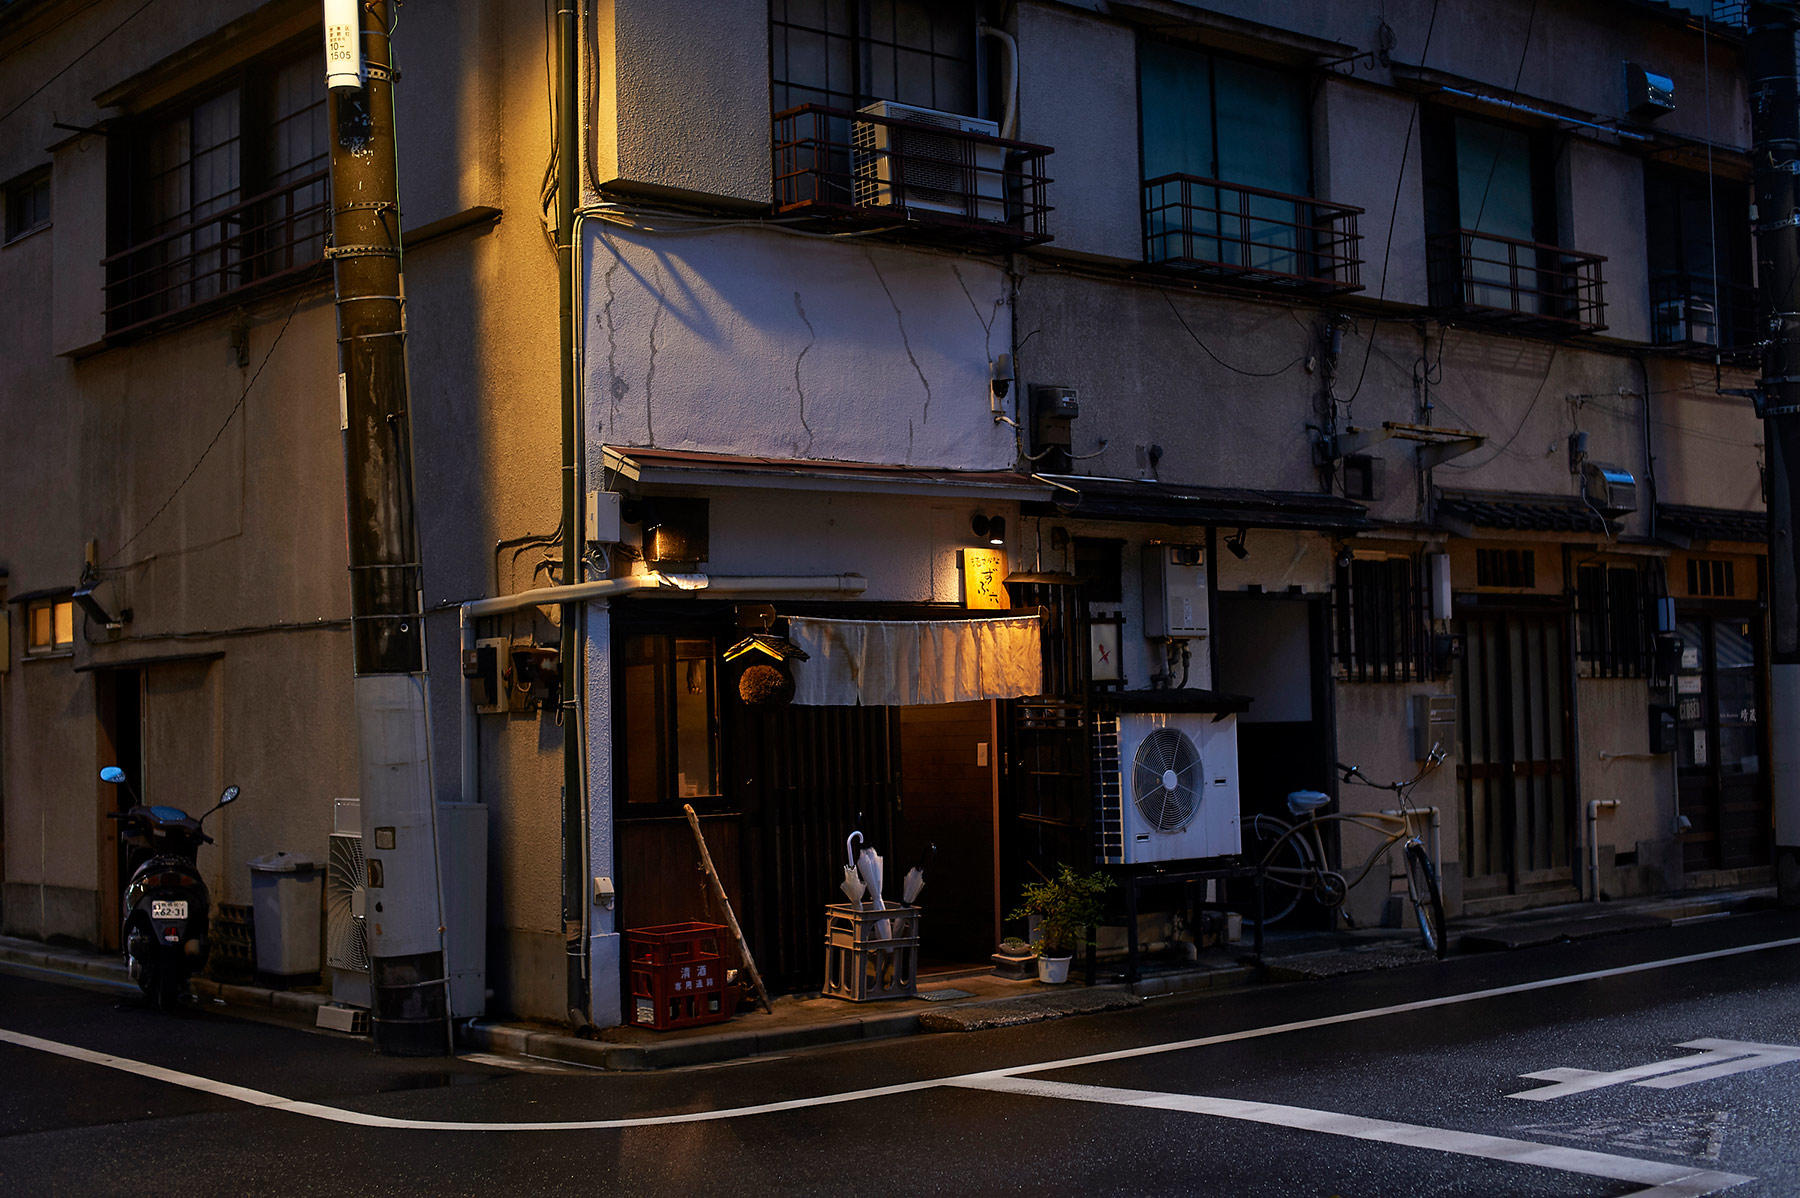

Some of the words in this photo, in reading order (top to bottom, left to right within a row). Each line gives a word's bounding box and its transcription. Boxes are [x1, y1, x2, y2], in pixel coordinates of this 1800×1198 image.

[330, 51, 351, 60] 1505
[160, 907, 184, 917] 62-31
[680, 965, 707, 979] 清酒
